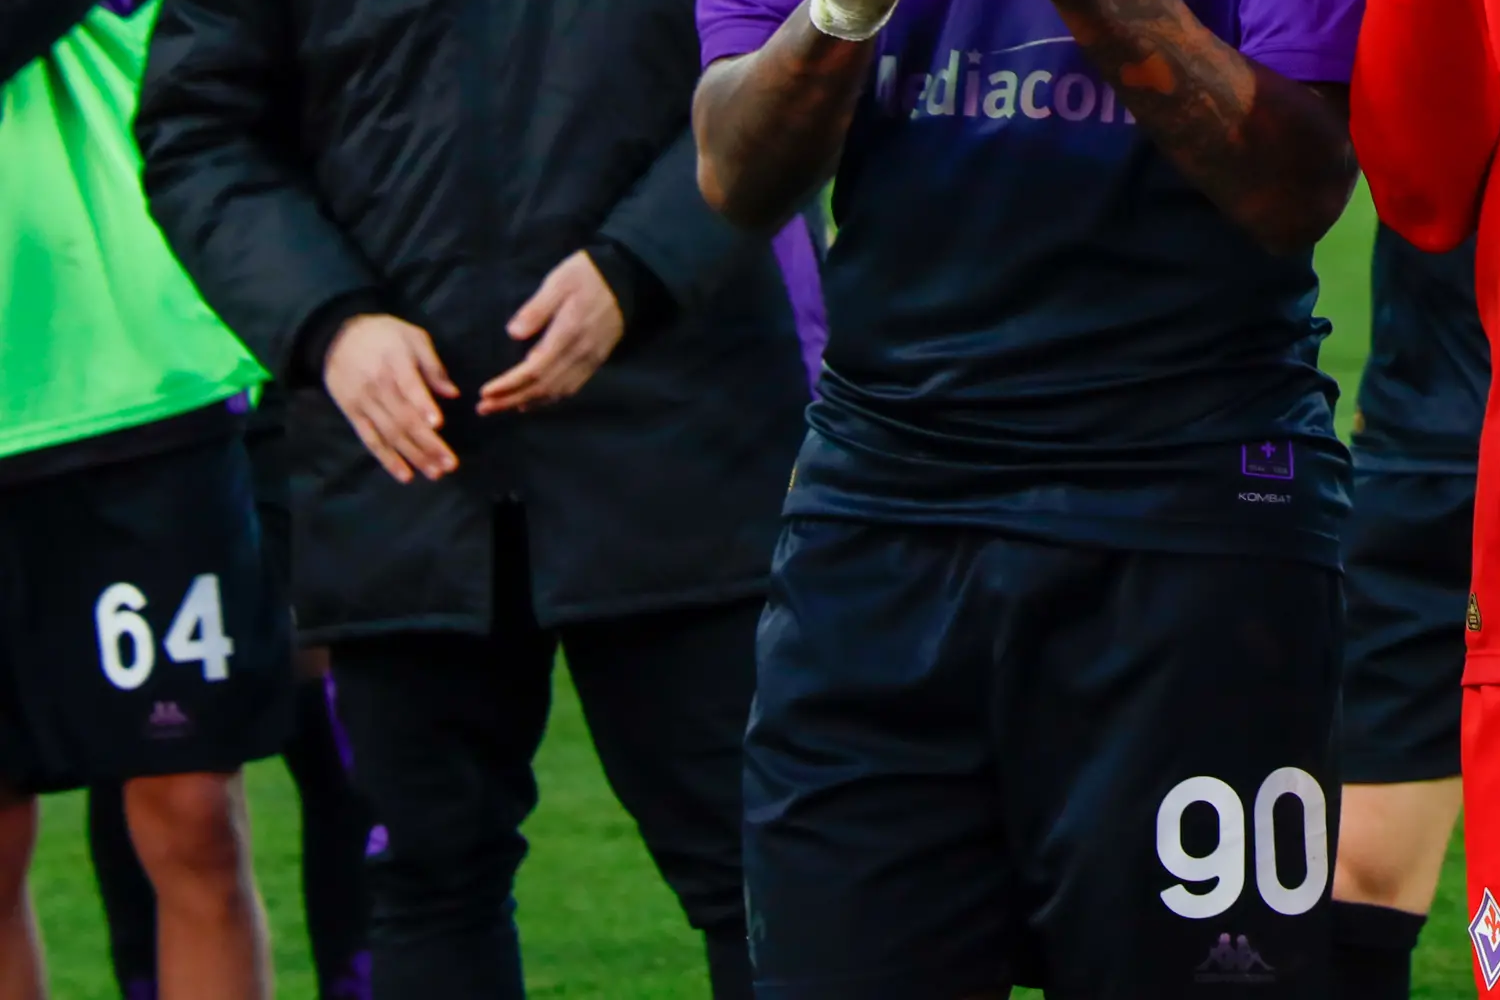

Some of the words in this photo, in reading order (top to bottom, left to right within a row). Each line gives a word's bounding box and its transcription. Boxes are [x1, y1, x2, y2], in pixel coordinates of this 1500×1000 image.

[1238, 492, 1292, 504] KOMBAT
[95, 573, 235, 690] 64
[1156, 766, 1329, 919] 90
